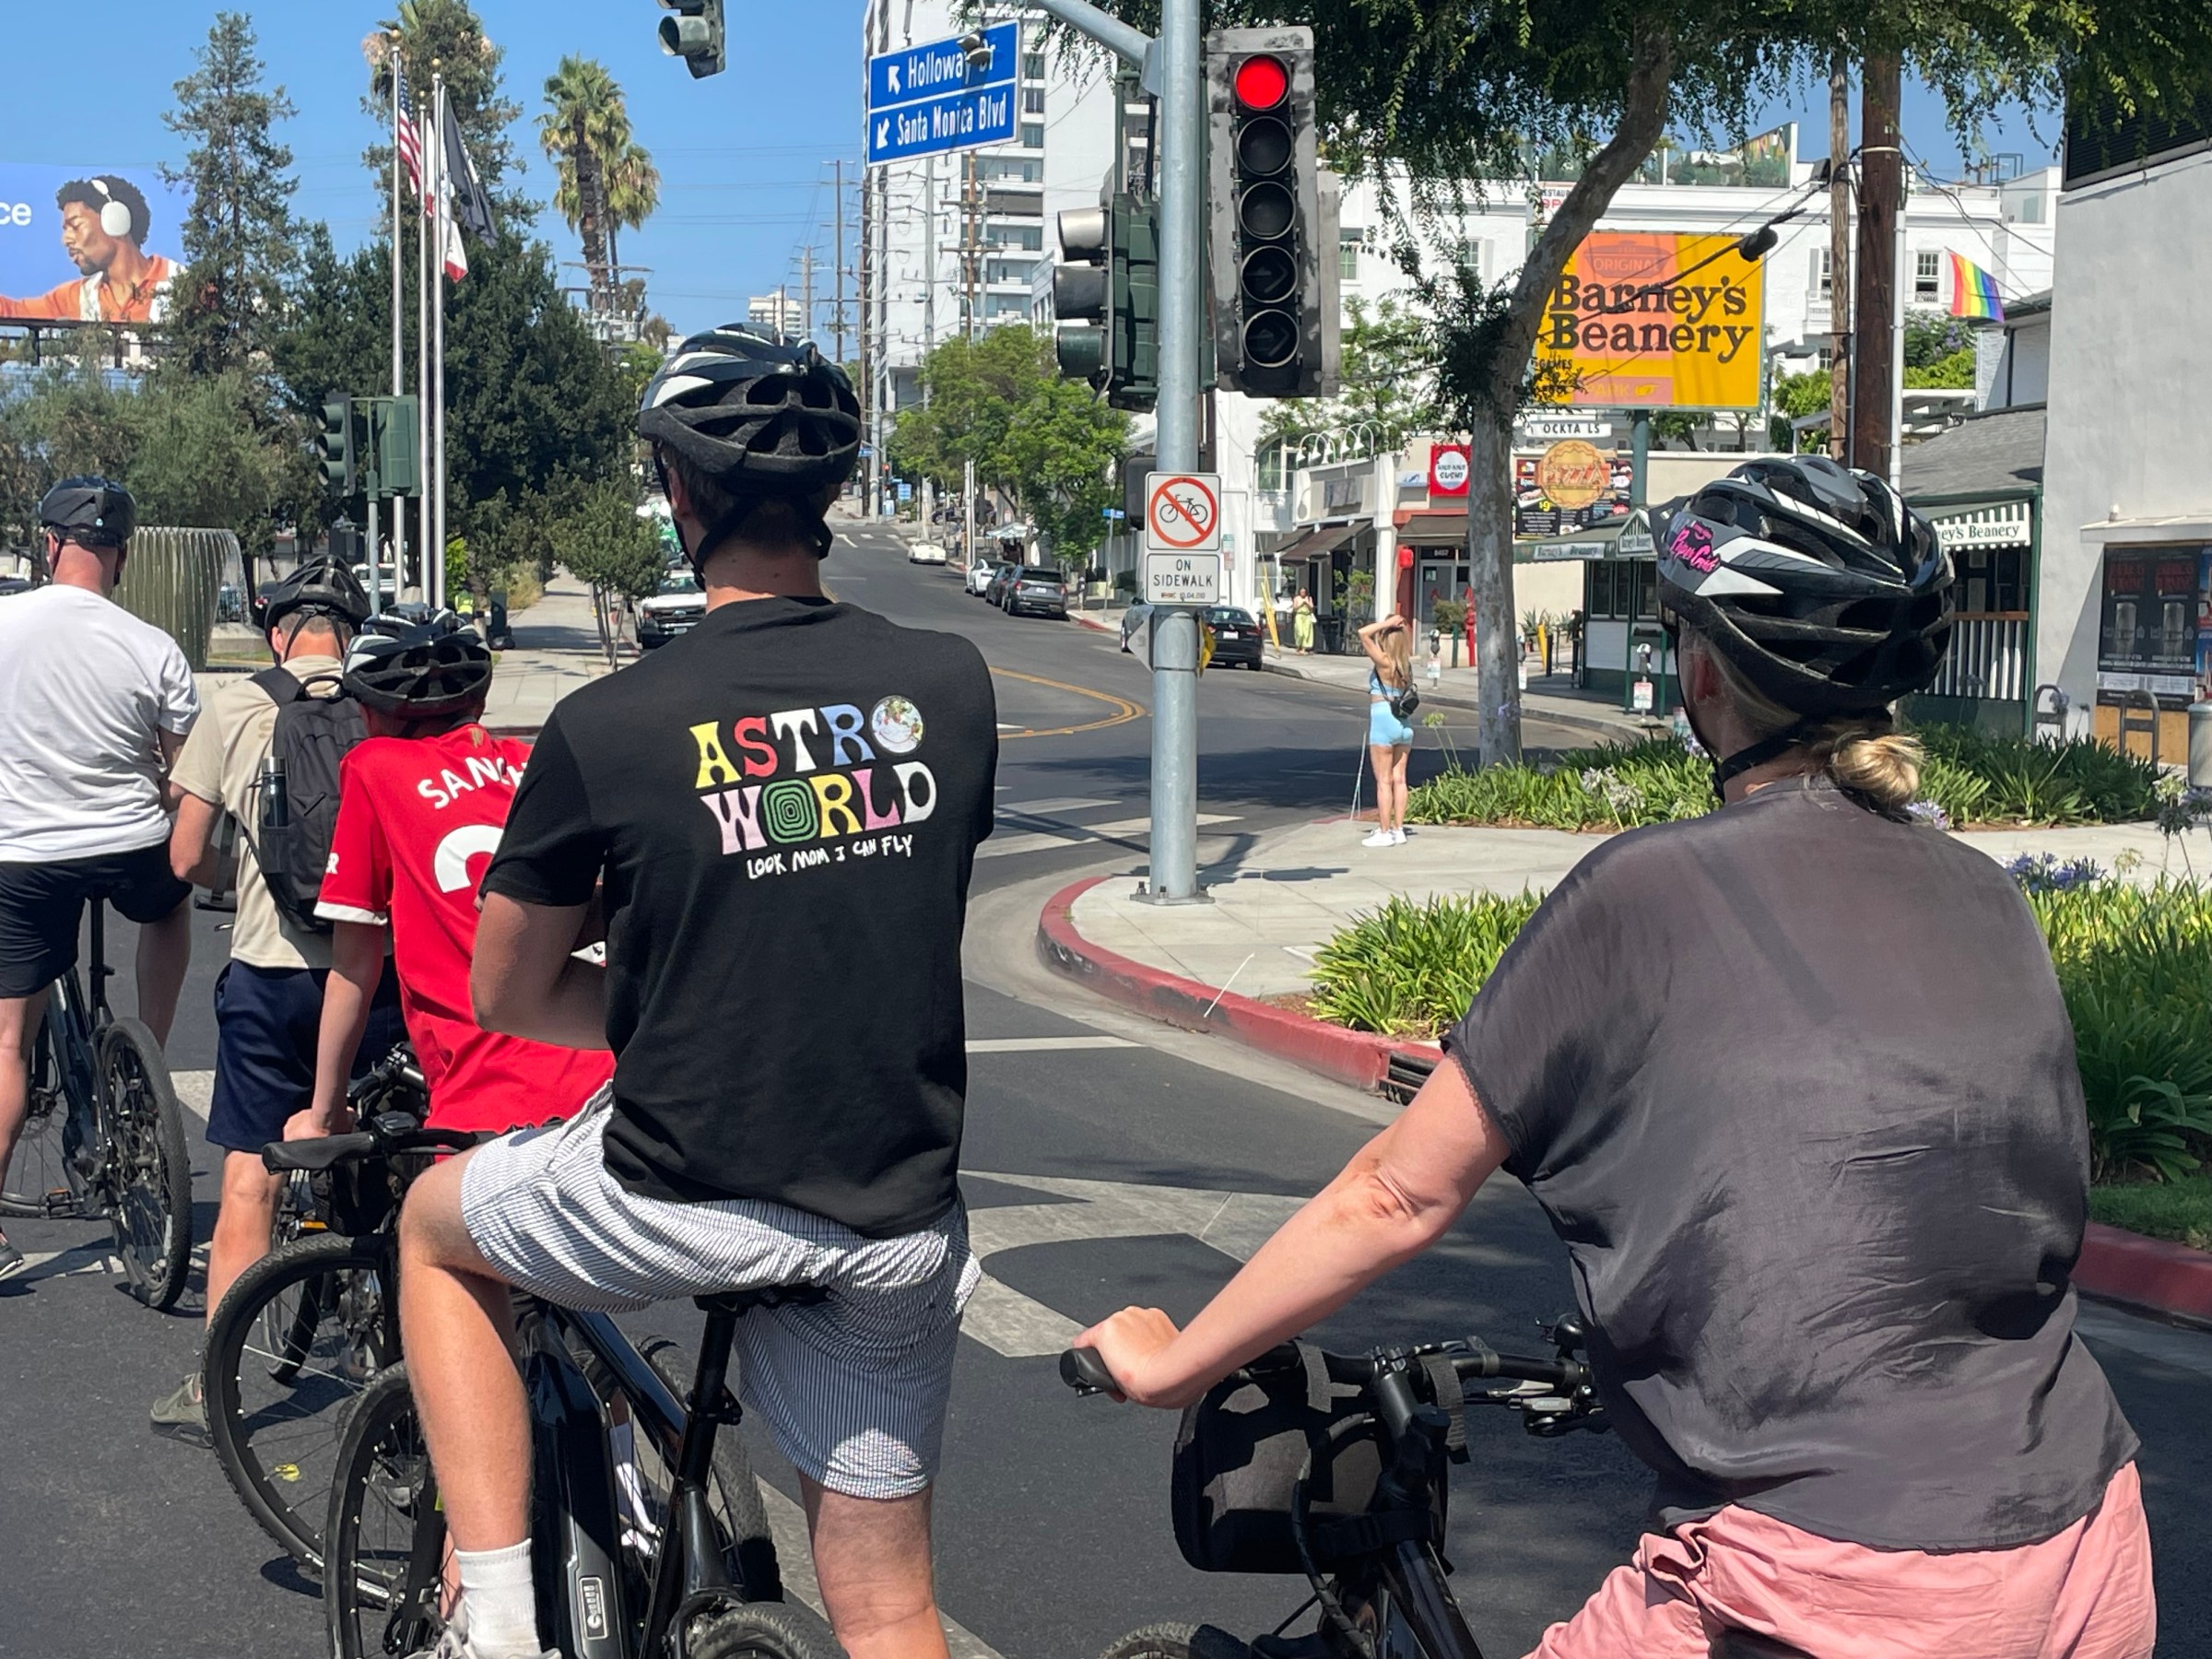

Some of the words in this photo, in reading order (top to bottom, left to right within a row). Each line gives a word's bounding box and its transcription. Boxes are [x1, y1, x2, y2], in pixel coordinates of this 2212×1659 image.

[897, 110, 928, 146] Santa
[933, 100, 973, 138] Monica
[979, 91, 1006, 130] Blvd
[1594, 258, 1661, 272] ORIGINAL
[1549, 275, 1747, 324] Barney's
[1548, 314, 1753, 364] Beanery
[1969, 525, 2019, 538] Beanery
[1153, 574, 1213, 587] SIDEWALK
[1175, 559, 1192, 571] ON
[700, 760, 937, 854] WORLD
[747, 853, 787, 879] LOOK
[792, 847, 830, 872] MOM
[853, 838, 877, 856] CAN
[881, 833, 913, 858] FLY
